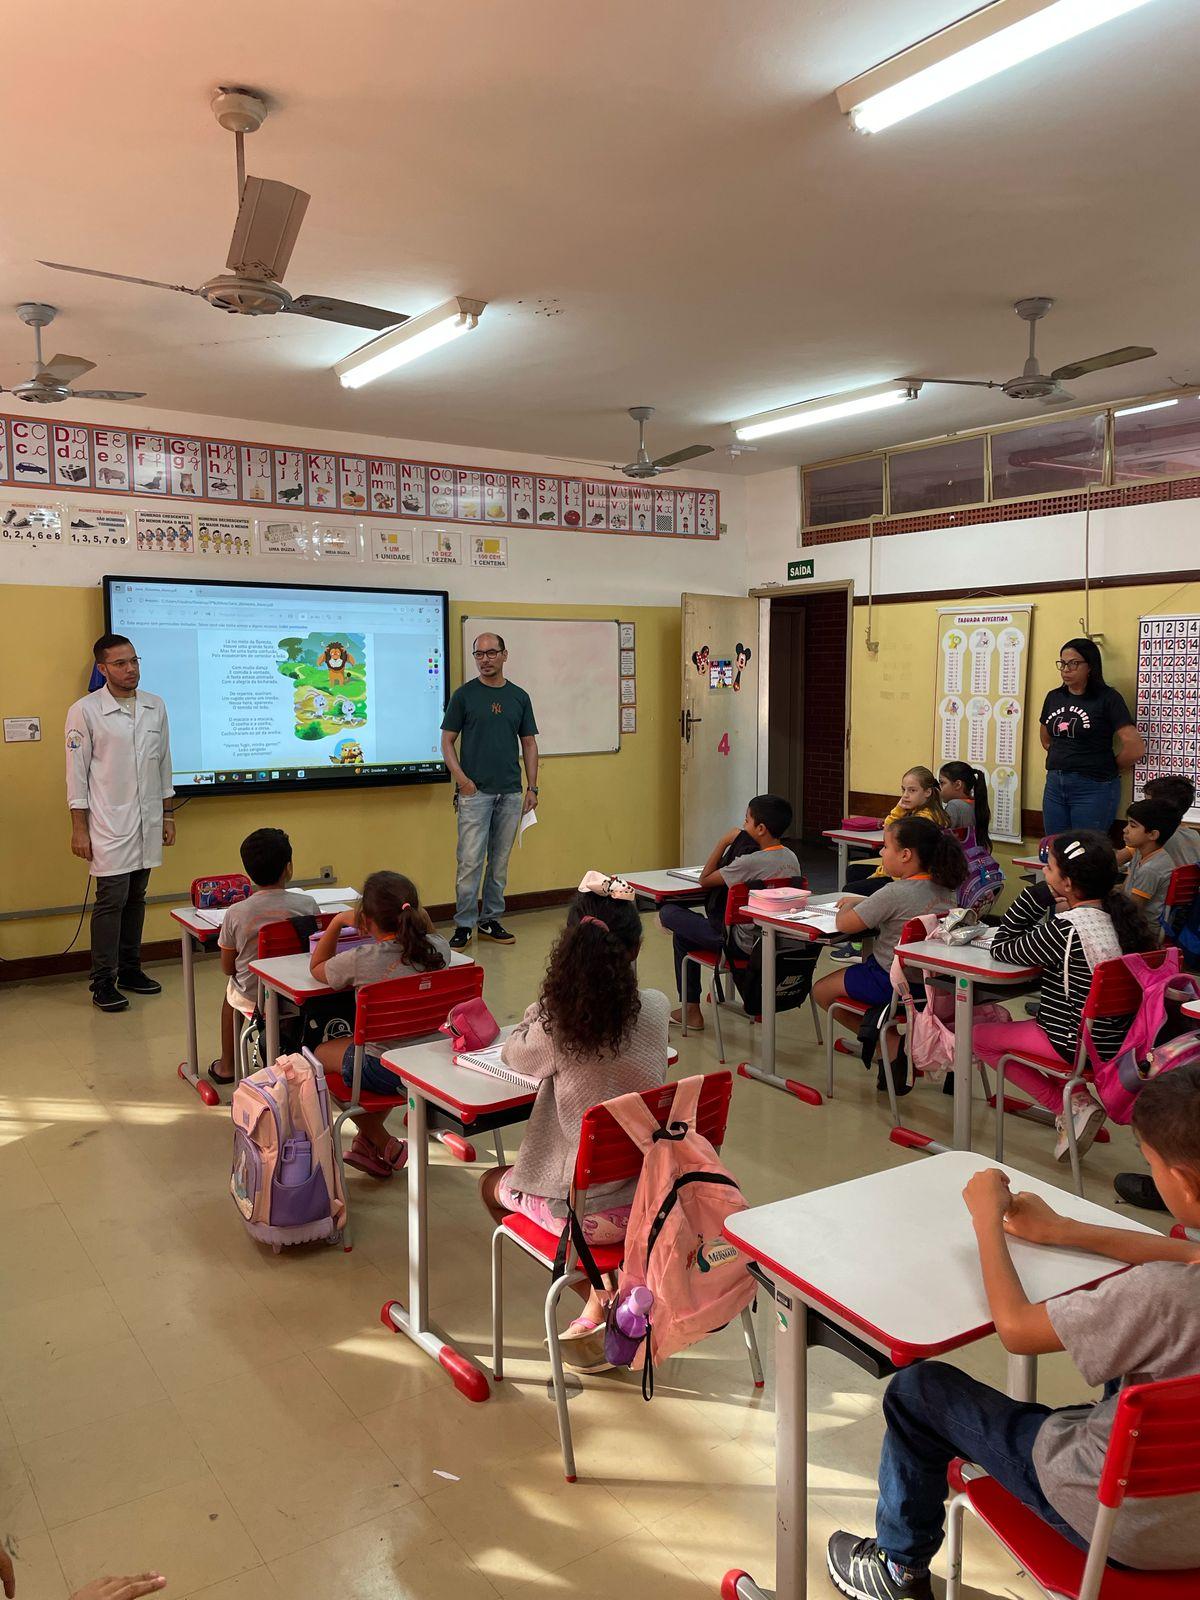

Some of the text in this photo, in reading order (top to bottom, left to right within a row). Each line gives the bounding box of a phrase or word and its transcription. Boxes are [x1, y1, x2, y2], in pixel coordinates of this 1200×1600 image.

[790, 564, 811, 576] SAÍDA
[1144, 622, 1197, 633] 0 1 2 3 4
[1141, 639, 1198, 650] 10 11 12 13 14
[1141, 656, 1198, 666] 20 21 22 23 24
[1140, 674, 1197, 683] 30 31 32 33 34
[1139, 690, 1196, 700] 40 41 42 43 44
[1069, 706, 1090, 728] CLASSIC
[1139, 706, 1196, 717] 50 51 52 53 54
[1138, 723, 1195, 734] 60 61 62 63 64
[718, 733, 730, 756] 4
[1151, 740, 1194, 751] 71 72 73 74
[1150, 756, 1194, 768] 81 82 83 84
[1136, 772, 1146, 781] 90
[708, 1249, 737, 1262] MERMAID
